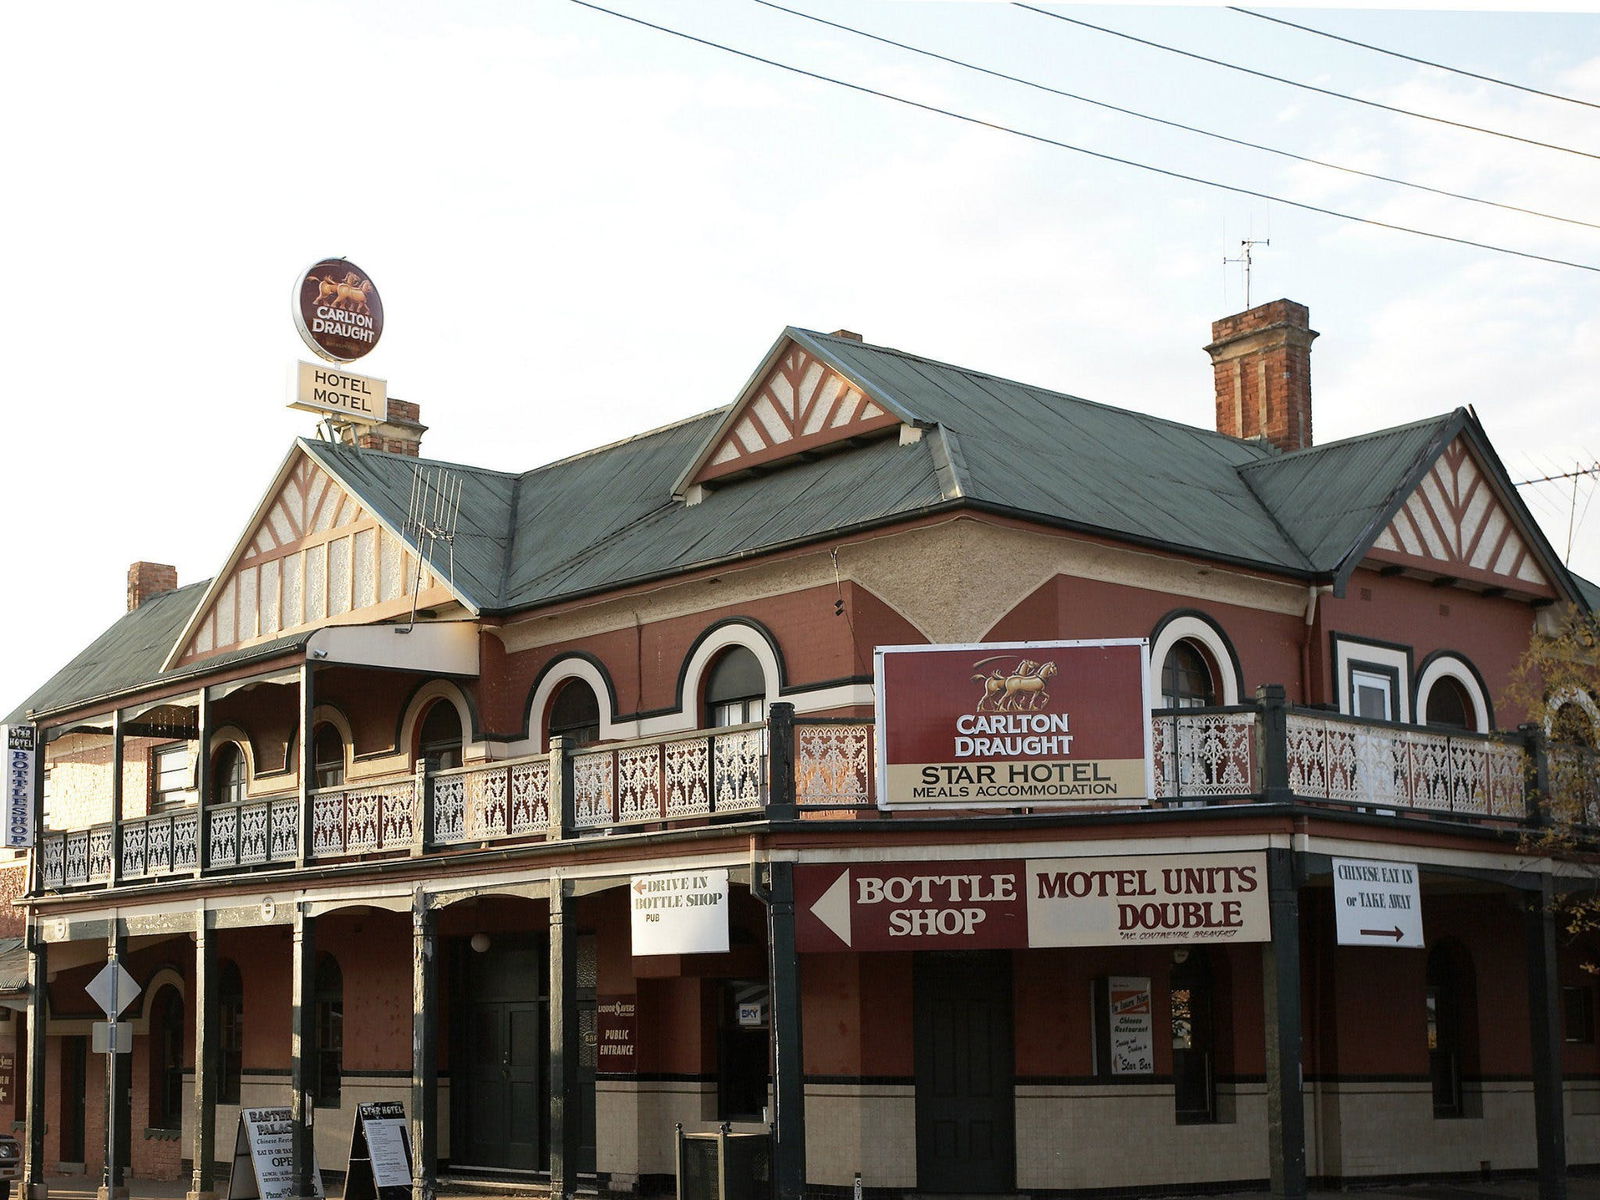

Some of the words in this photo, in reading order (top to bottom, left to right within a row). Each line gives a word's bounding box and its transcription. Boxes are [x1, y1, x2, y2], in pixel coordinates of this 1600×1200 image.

[317, 306, 373, 329] CARLTON
[312, 318, 375, 343] DRAUGHT
[315, 370, 371, 395] HOTEL
[314, 388, 371, 413] MOTEL
[11, 728, 31, 738] STAR
[956, 713, 1069, 735] CARLTON
[9, 738, 33, 748] HOTEL
[954, 735, 1074, 757] DRAUGHT
[921, 764, 996, 785] STAR
[1008, 762, 1112, 784] HOTEL
[912, 786, 970, 798] MEALS
[975, 783, 1118, 797] ACCOMMODATION
[647, 878, 689, 892] DRIVE
[692, 876, 708, 890] IN
[1036, 869, 1156, 900] MOTEL
[1163, 866, 1258, 895] UNITS
[1338, 865, 1380, 882] CHINESE
[1381, 867, 1400, 883] EAT
[1402, 869, 1413, 885] IN
[856, 873, 1017, 905] BOTTLE
[635, 894, 684, 910] BOTTLE
[685, 892, 723, 907] SHOP
[1358, 892, 1386, 909] TAKE
[1388, 894, 1411, 910] AWAY
[645, 913, 660, 923] PUB
[888, 907, 987, 938] SHOP
[1117, 901, 1244, 930] DOUBLE
[605, 1029, 629, 1040] PUBLIC
[600, 1044, 634, 1056] ENTRANCE
[1121, 1059, 1137, 1071] Star
[1138, 1058, 1152, 1070] Bar
[363, 1105, 381, 1116] STAR
[382, 1105, 403, 1115] HOTEL
